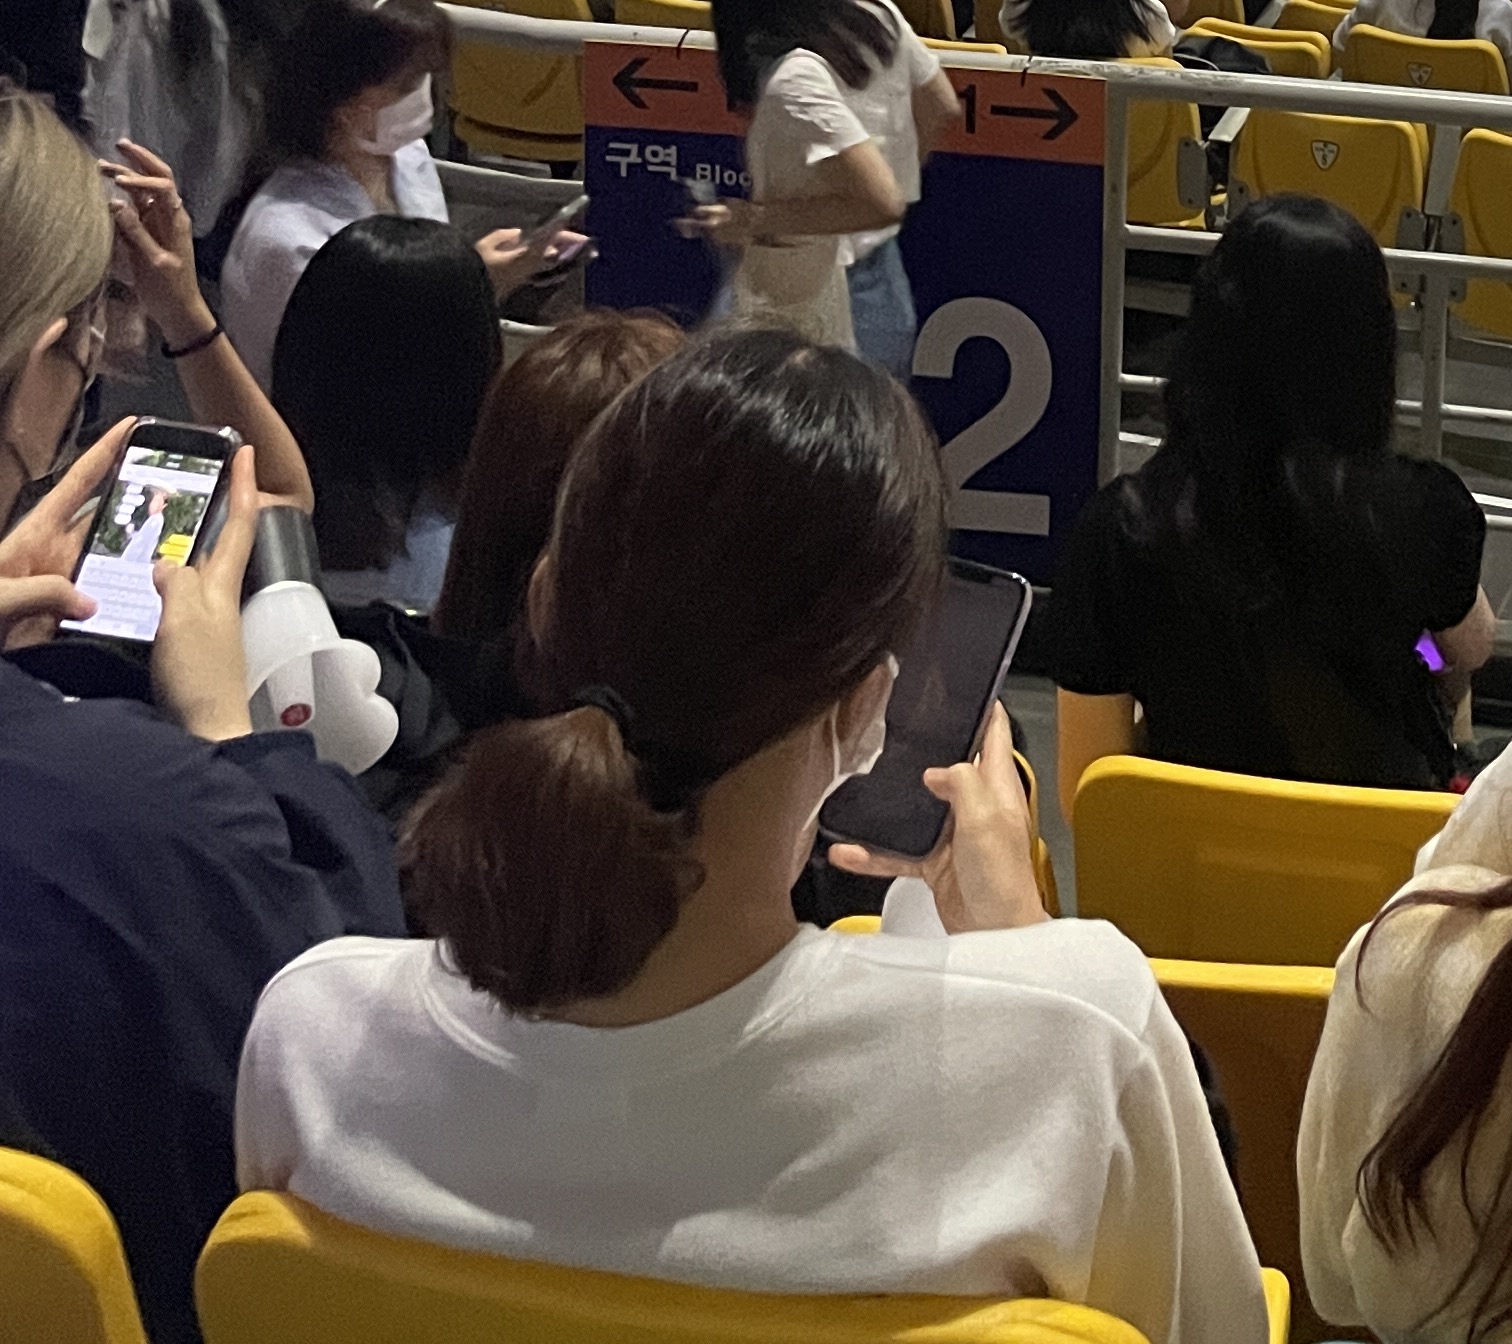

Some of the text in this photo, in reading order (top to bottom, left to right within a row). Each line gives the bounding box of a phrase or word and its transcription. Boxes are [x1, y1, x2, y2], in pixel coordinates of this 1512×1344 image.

[958, 83, 977, 135] 1
[605, 141, 678, 181] 구역
[696, 162, 753, 187] Bloc
